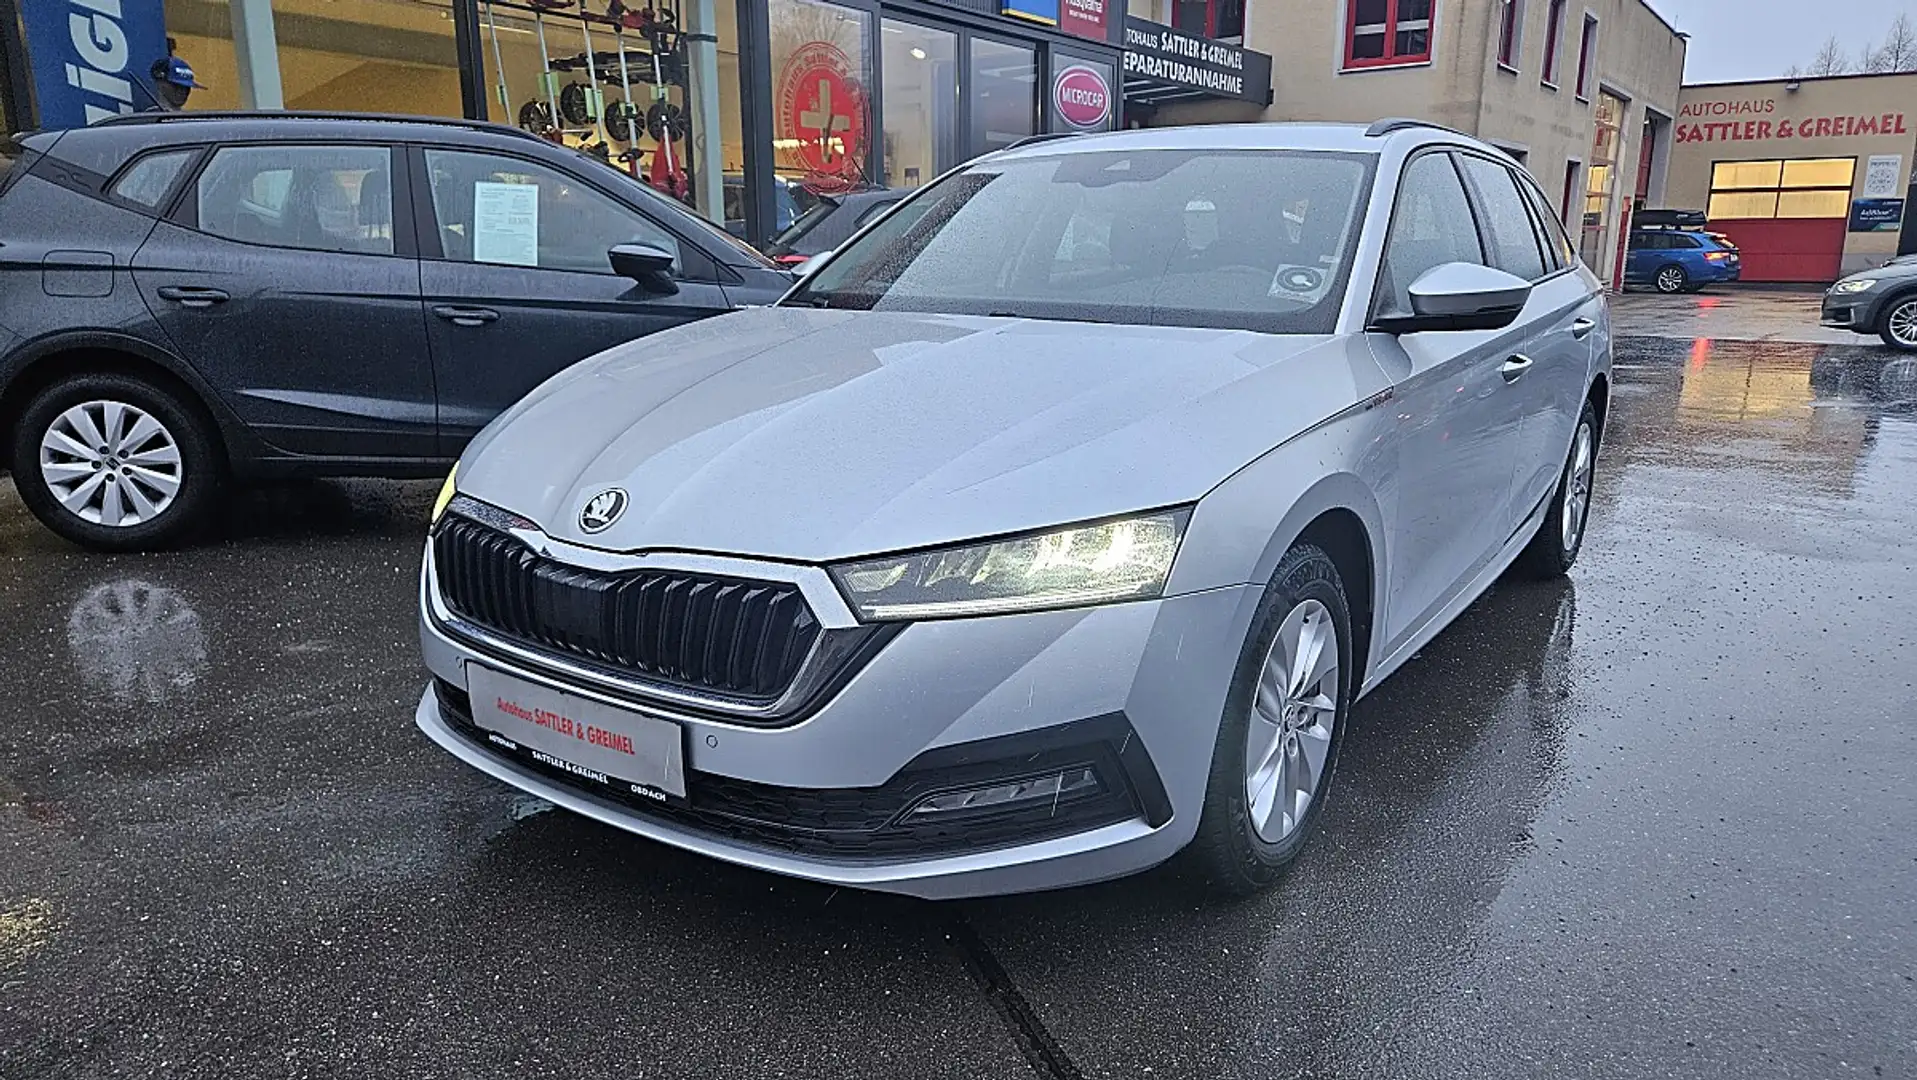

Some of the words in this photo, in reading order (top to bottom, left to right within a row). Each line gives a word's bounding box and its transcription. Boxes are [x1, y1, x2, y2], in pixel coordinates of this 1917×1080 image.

[1126, 28, 1158, 49] TOHAUS
[1161, 32, 1200, 59] SATTLER
[1201, 43, 1207, 62] &
[1208, 45, 1243, 70] GREIMEL
[1124, 51, 1243, 94] EPARATURANNAHME
[1062, 86, 1104, 109] MICROCAR
[1680, 99, 1775, 117] AUTOHAUS
[1676, 120, 1772, 143] SATTLER
[1776, 119, 1793, 138] &
[1798, 114, 1907, 137] GREIMEL
[496, 697, 533, 722] Autohaus
[534, 708, 574, 737] SATTLER
[576, 722, 585, 740] &
[587, 725, 635, 755] GREIMEL
[532, 751, 565, 769] SATTLER
[572, 765, 608, 784] GREIMEL
[631, 785, 666, 801] OBDACH
